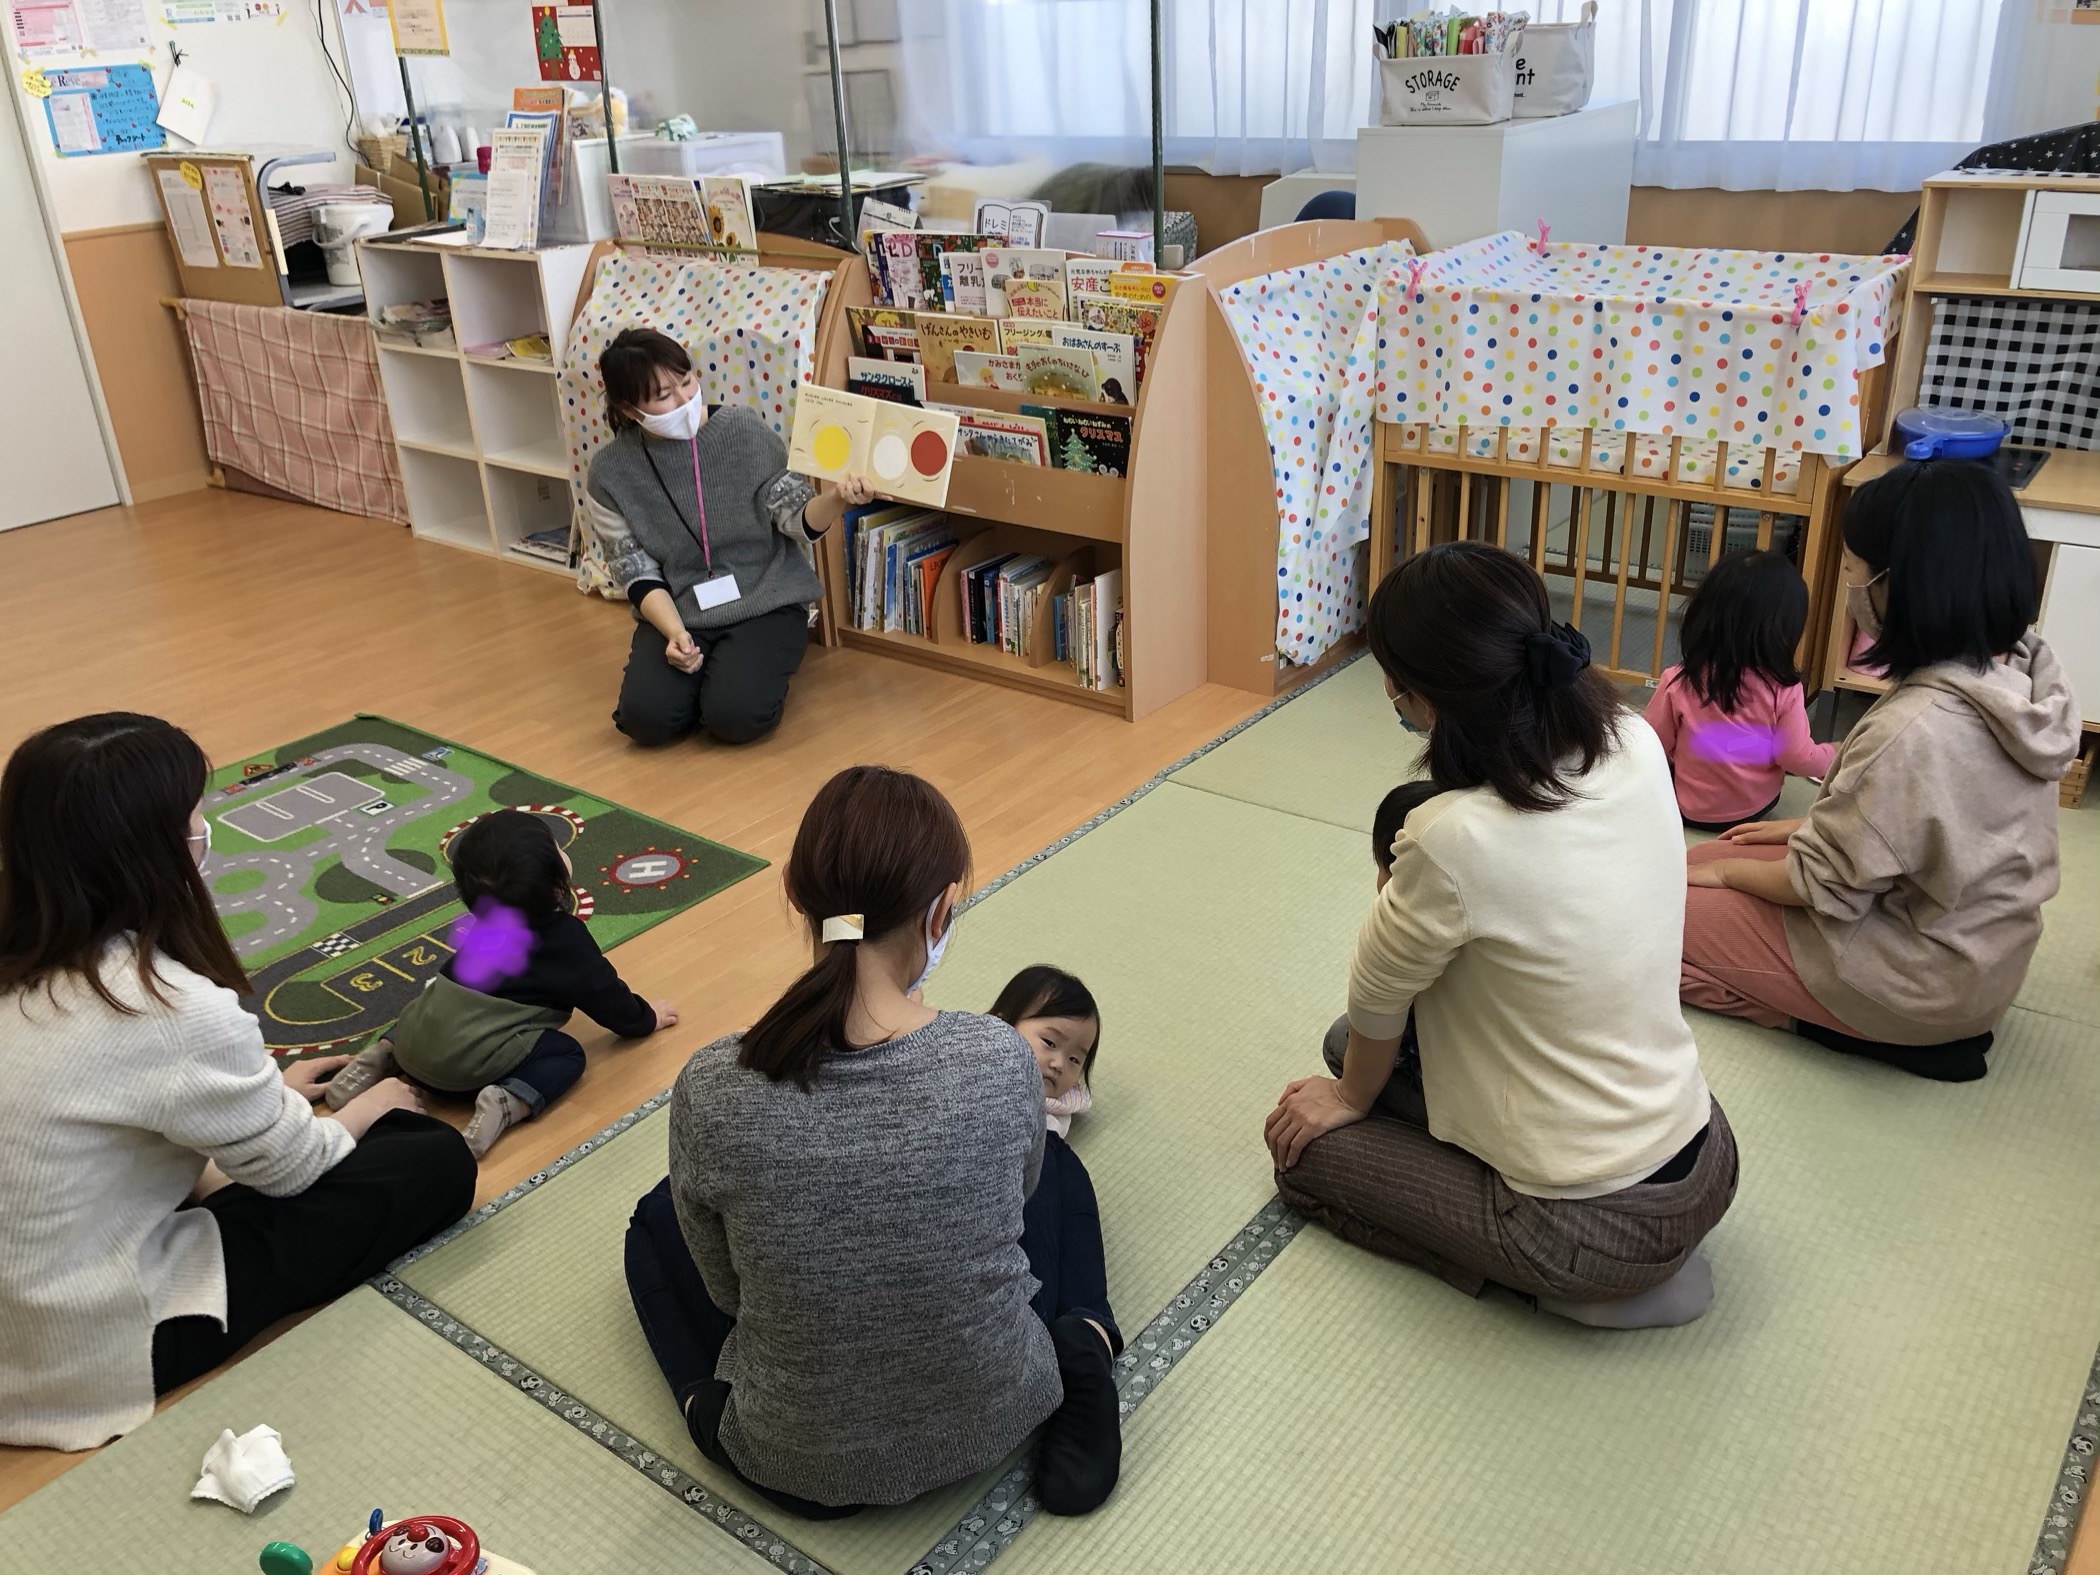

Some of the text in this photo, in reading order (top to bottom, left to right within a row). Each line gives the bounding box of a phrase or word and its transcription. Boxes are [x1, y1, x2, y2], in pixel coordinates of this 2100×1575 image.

[1405, 70, 1461, 93] STORAGE
[985, 217, 1007, 231] ドレミ
[959, 276, 985, 287] 離乳
[1027, 296, 1049, 307] 本当に
[1017, 306, 1059, 319] 伝えたいこと
[1062, 336, 1121, 353] おばあさんのすーぷ
[860, 371, 914, 388] サンタクロースと
[1080, 426, 1124, 443] クリスマス
[366, 802, 388, 812] P
[629, 860, 668, 880] H
[401, 945, 438, 966] 2
[349, 972, 384, 992] 3
